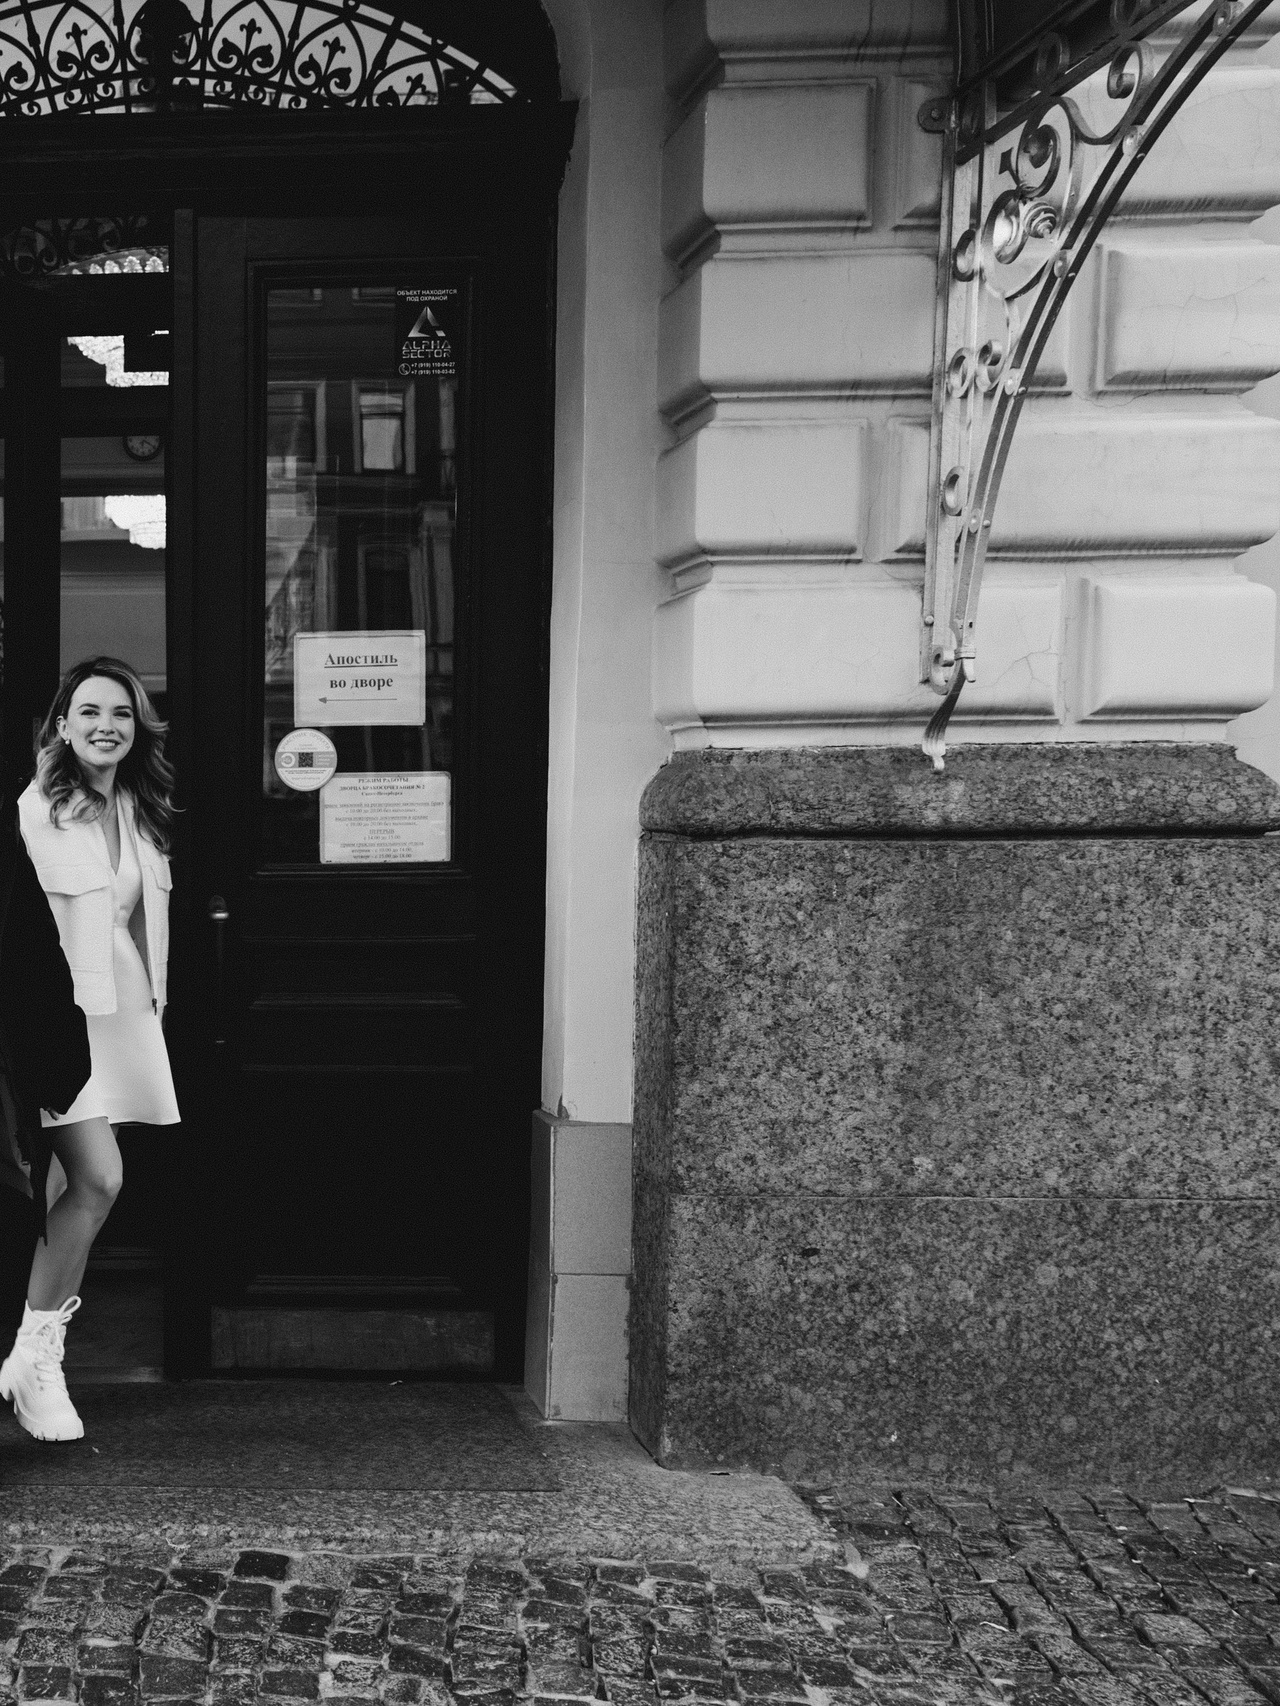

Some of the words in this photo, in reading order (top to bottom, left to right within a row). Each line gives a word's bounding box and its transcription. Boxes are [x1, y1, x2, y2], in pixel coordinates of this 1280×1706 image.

[402, 340, 451, 349] ALPHA
[402, 349, 451, 358] SECTOR
[324, 653, 398, 666] Апостиль
[330, 679, 347, 689] во
[350, 677, 394, 691] дворе
